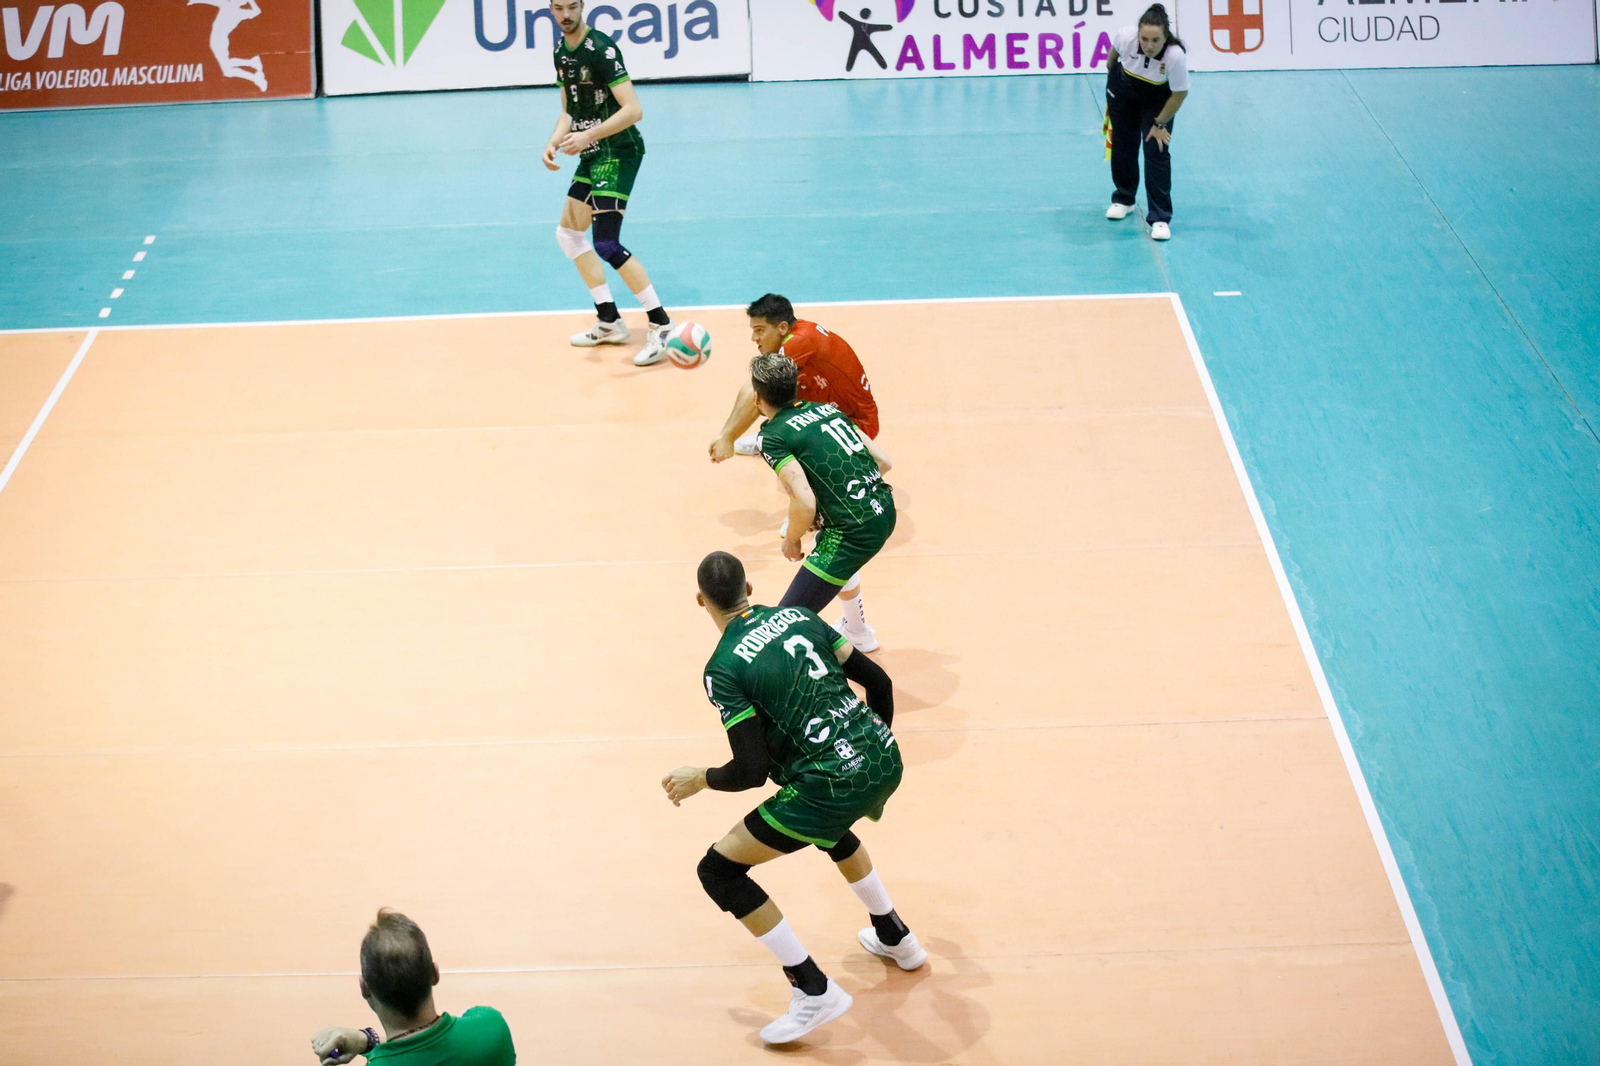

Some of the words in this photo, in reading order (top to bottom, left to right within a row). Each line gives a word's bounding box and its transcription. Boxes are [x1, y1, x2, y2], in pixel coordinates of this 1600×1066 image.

[473, 0, 719, 60] Uncaja
[895, 20, 1113, 72] ALMERÍA
[1317, 15, 1440, 43] CIUDAD
[35, 67, 109, 90] VOLEIBOL
[112, 63, 204, 87] MASCULINA
[821, 417, 866, 456] 10
[783, 634, 828, 680] 3
